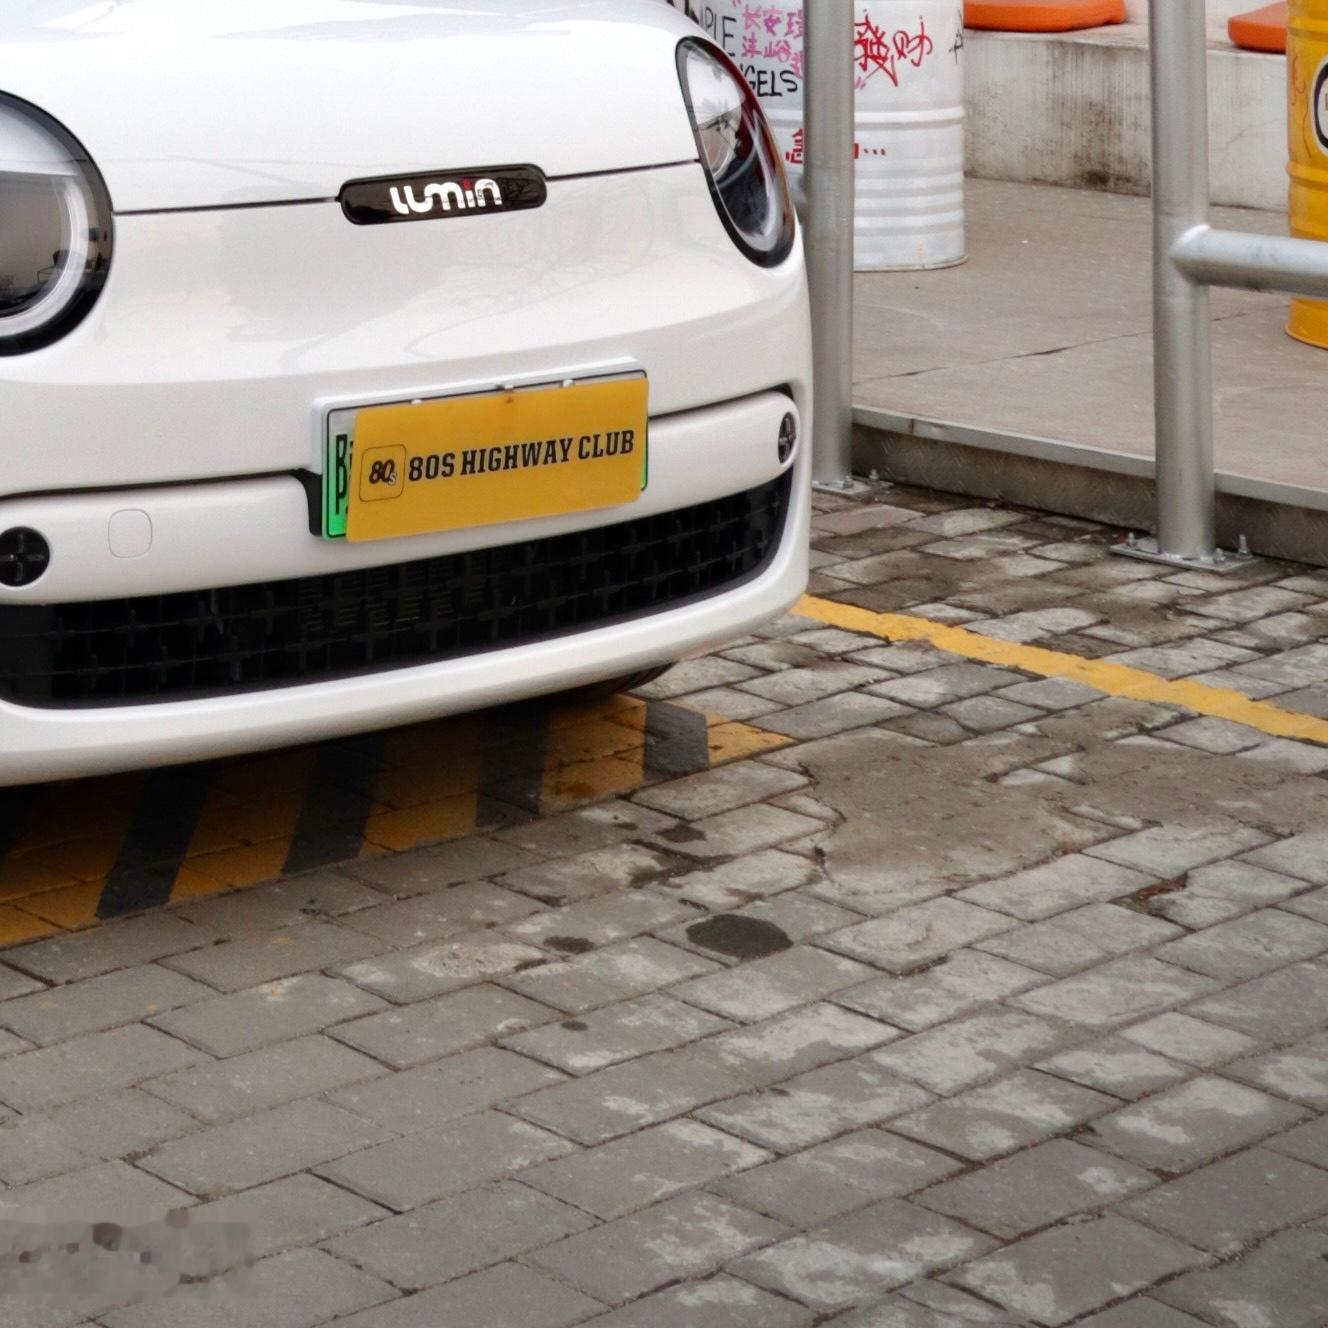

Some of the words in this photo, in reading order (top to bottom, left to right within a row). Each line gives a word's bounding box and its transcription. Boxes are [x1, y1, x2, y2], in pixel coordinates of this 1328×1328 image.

[408, 452, 456, 482] 80S
[460, 436, 575, 476] HIGHWAY
[578, 428, 636, 461] CLUB
